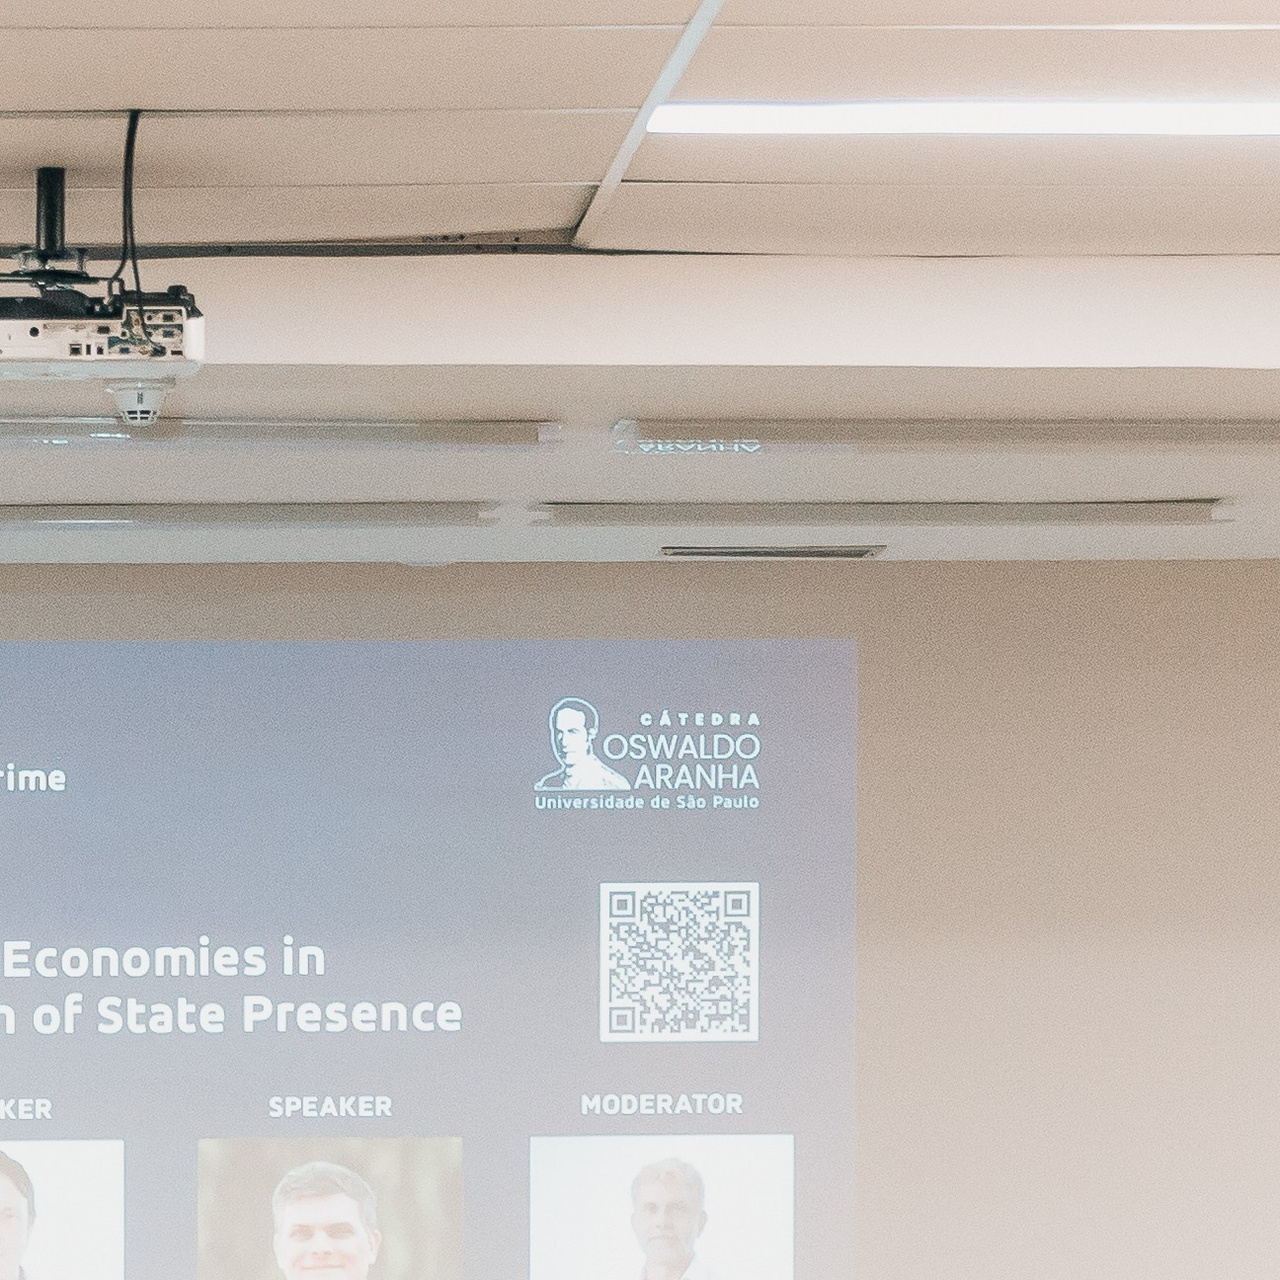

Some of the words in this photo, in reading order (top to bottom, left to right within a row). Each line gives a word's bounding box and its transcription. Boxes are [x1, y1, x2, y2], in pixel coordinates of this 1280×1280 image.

[639, 709, 761, 726] CÁTEDRA
[603, 733, 761, 760] OSWALDO
[634, 763, 760, 789] ARANHA
[534, 794, 644, 810] Universidade
[650, 794, 670, 809] de
[676, 794, 707, 809] São
[713, 794, 759, 809] Paulo
[2, 935, 268, 978] Economies
[282, 934, 325, 976] in
[32, 992, 84, 1036] of
[96, 996, 226, 1035] State
[242, 995, 463, 1033] Presence
[267, 1095, 394, 1119] SPEAKER
[579, 1092, 745, 1116] MODERATOR
